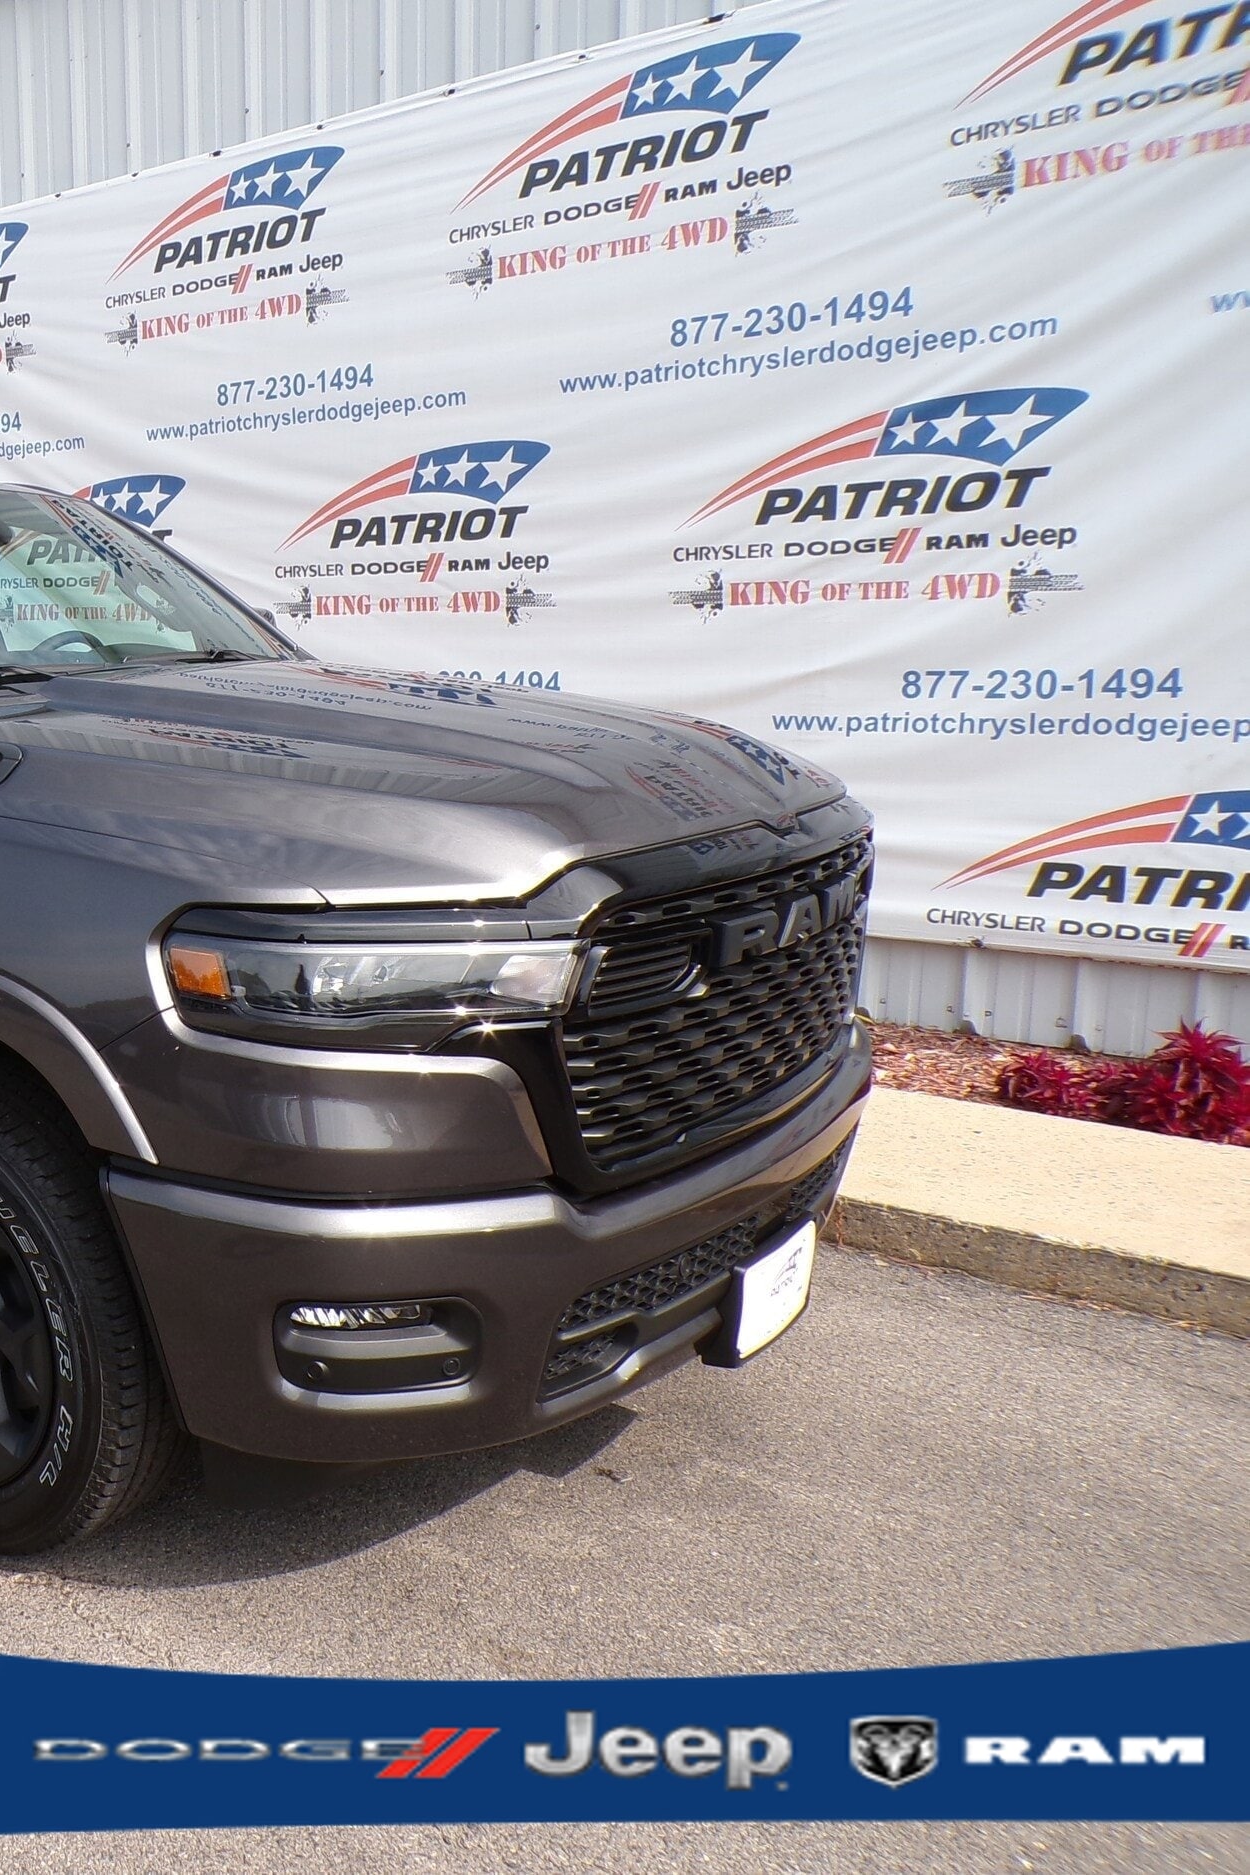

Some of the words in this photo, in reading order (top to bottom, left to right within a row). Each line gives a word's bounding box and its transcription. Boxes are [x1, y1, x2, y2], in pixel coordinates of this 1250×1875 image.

[950, 103, 1082, 147] CHRYSLER
[1095, 67, 1248, 118] DODGE
[518, 109, 770, 199] PATRIOT
[1023, 141, 1130, 188] KING
[1143, 135, 1184, 162] OF
[449, 214, 535, 244] CHRYSLER
[544, 193, 641, 226] DODGE
[664, 179, 717, 203] RAM
[727, 164, 792, 191] Jeep
[153, 208, 326, 274] PATRIOT
[498, 245, 567, 279] KING
[576, 242, 602, 264] OF
[608, 234, 651, 257] THE
[661, 216, 728, 250] 4WD
[105, 287, 166, 309] CHRYSLER
[172, 273, 239, 296] DODGE
[256, 264, 293, 281] RAM
[299, 253, 344, 273] Jeep
[141, 313, 190, 340] KING
[196, 311, 214, 329] OF
[217, 306, 248, 325] THE
[254, 293, 302, 320] 4WD
[670, 286, 915, 348] 877-230-1494
[559, 315, 1058, 394] www.patriotchryslerdodgejeep.com
[216, 363, 373, 407] 877-230-1494
[146, 388, 467, 442] www.patriotchryslerdodgejeep.com
[754, 466, 1051, 525] PATRIOT
[330, 505, 529, 549] PATRIOT
[673, 543, 773, 563] CHRYSLER
[784, 537, 897, 558] DODGE
[926, 533, 989, 551] RAM
[1001, 524, 1077, 550] Jeep
[43, 576, 100, 588] DODGE
[275, 563, 343, 579] CHRYSLER
[351, 560, 429, 576] DODGE
[448, 558, 490, 572] RAM
[497, 551, 549, 573] Jeep
[729, 579, 811, 607] KING
[822, 582, 851, 602] OF
[859, 580, 909, 600] THE
[921, 573, 1000, 600] 4WD
[17, 603, 59, 621] KING
[64, 606, 79, 620] OF
[81, 606, 107, 620] THE
[315, 594, 371, 616] KING
[378, 597, 400, 613] OF
[404, 596, 439, 612] THE
[447, 590, 500, 613] 4WD
[901, 667, 1183, 700] 877-230-1494
[716, 872, 856, 968] RAM
[926, 908, 1046, 933] CHRYSLER
[1058, 919, 1197, 944] DODGE
[39, 1404, 74, 1487] H/L
